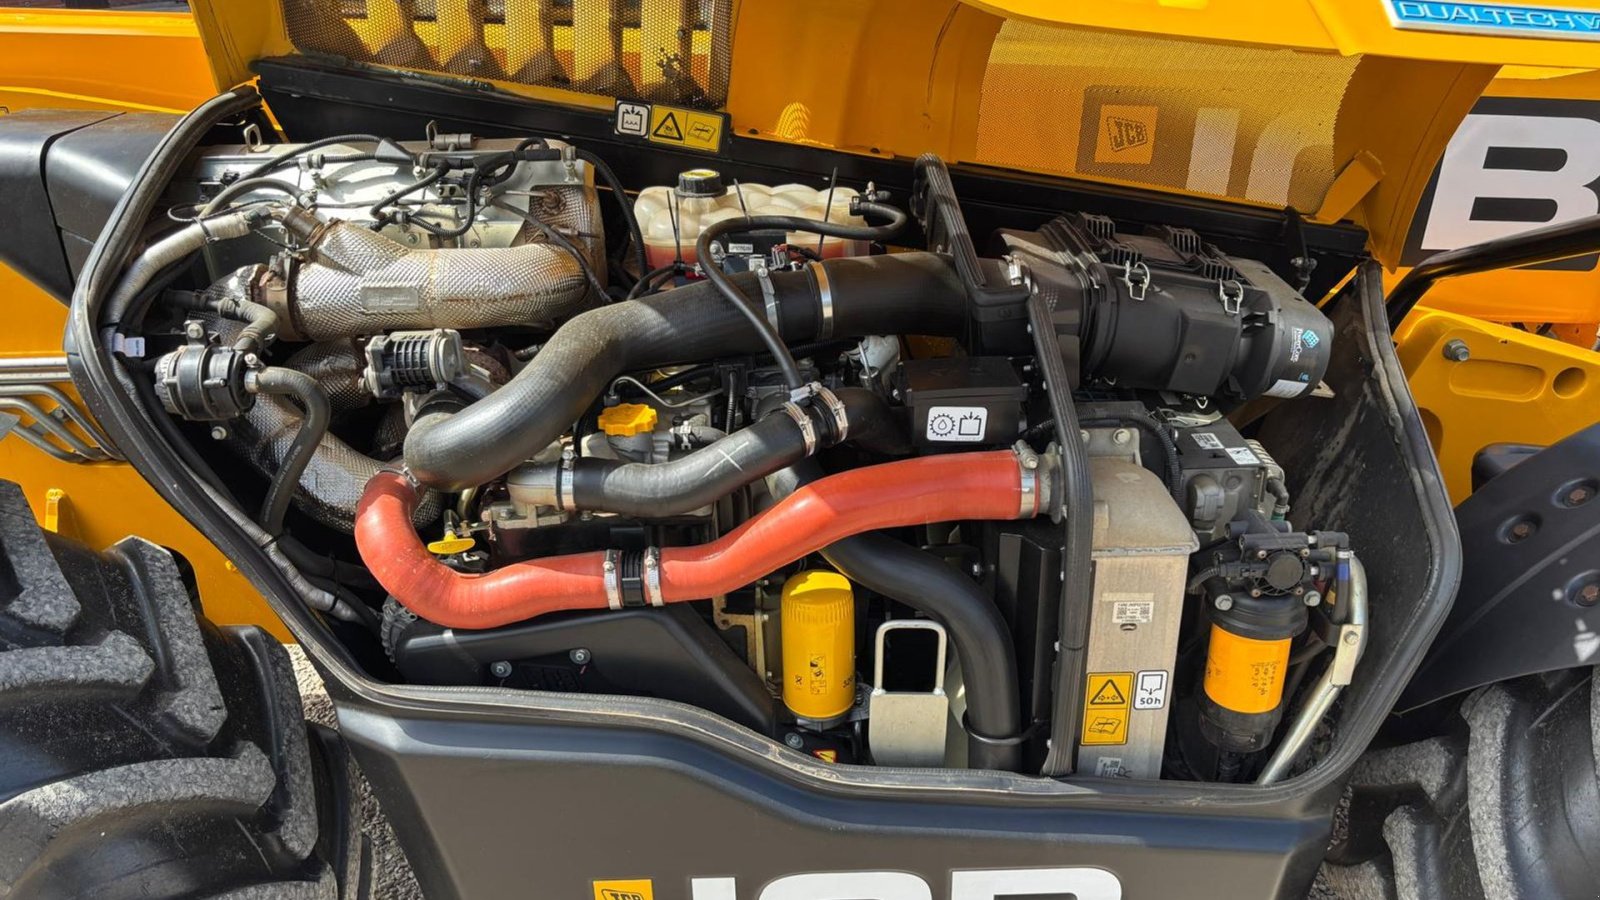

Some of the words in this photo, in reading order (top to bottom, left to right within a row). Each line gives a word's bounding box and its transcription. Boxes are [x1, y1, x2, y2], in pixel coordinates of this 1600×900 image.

[1399, 2, 1576, 28] DUALTECH
[1113, 119, 1147, 149] JCB
[1421, 113, 1600, 252] B
